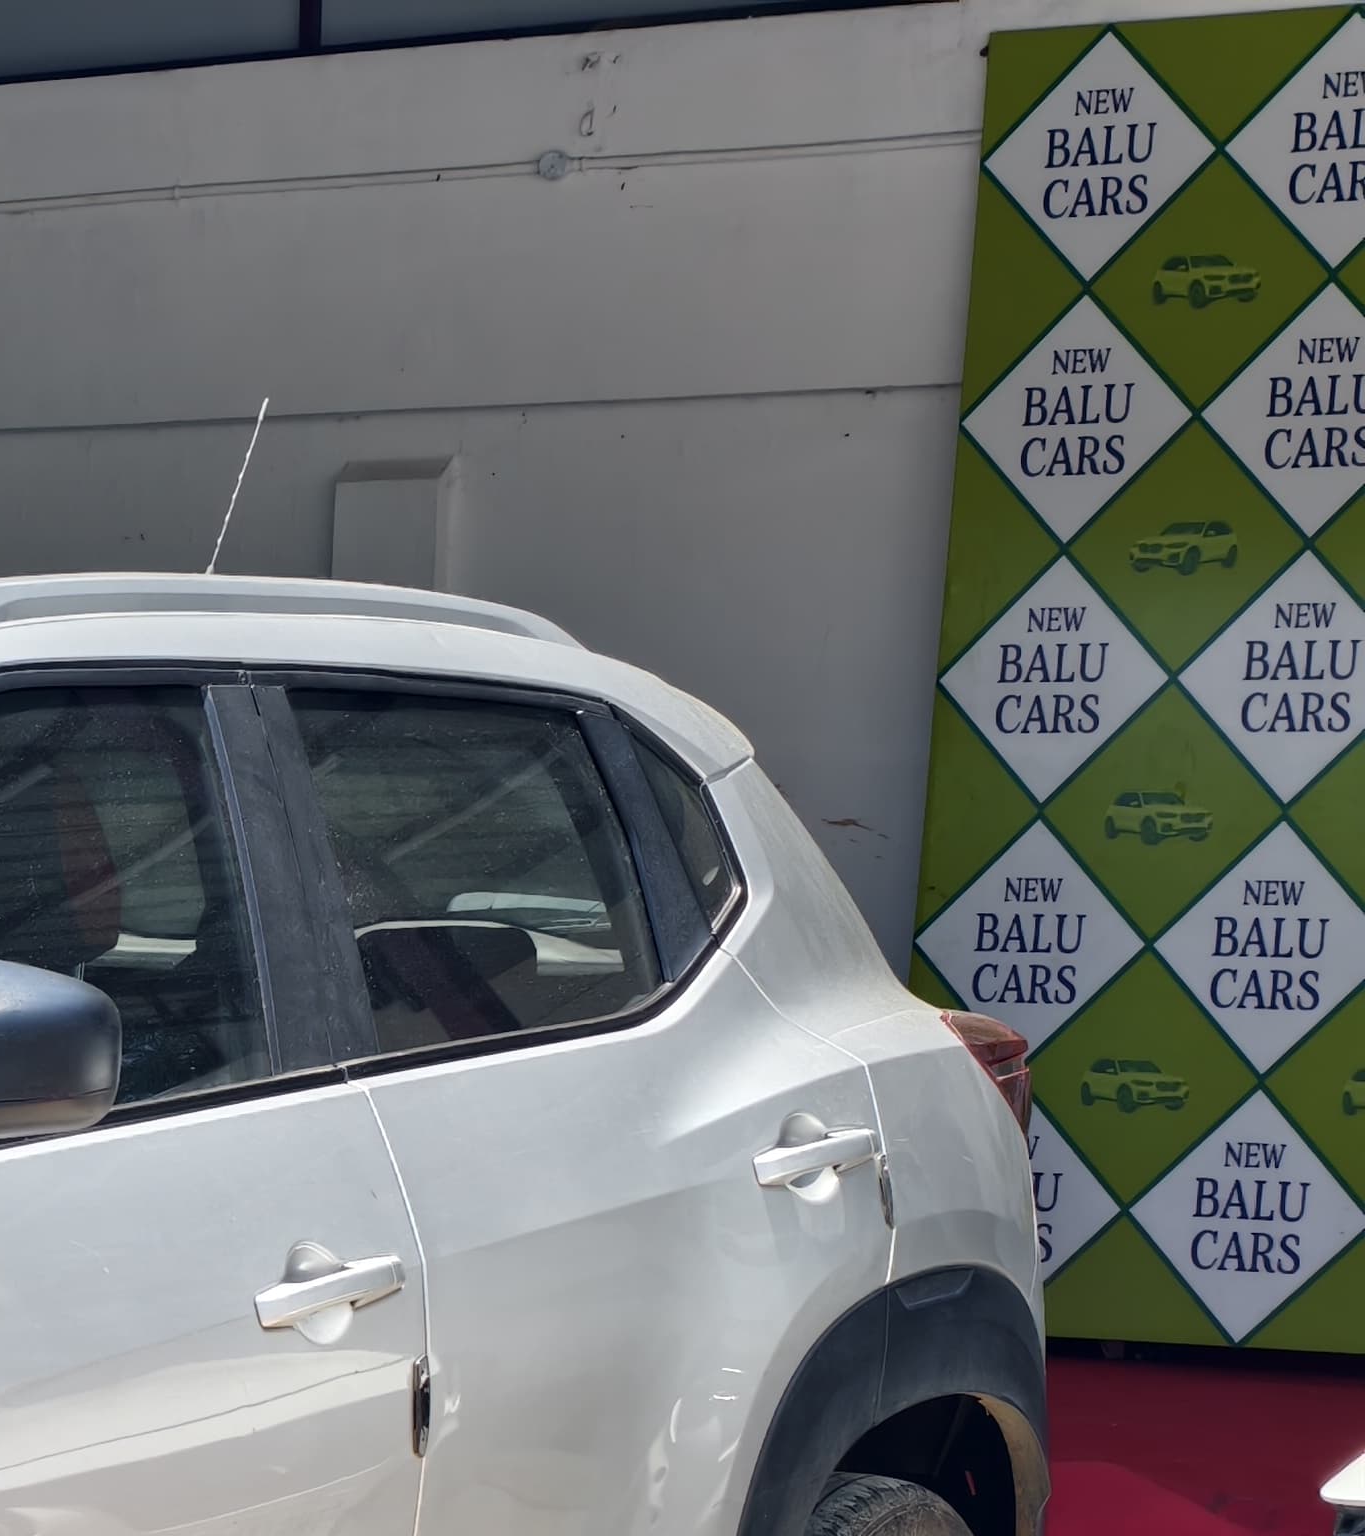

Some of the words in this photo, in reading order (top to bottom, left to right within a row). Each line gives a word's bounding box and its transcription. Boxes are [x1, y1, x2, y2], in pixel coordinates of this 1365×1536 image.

[1075, 87, 1134, 116] NEW
[1323, 71, 1365, 99] NE
[1045, 123, 1157, 168] BALU
[1043, 174, 1149, 219] CARS
[1052, 348, 1111, 375] NEW
[1298, 337, 1360, 364] NEW
[1022, 383, 1135, 426] BALU
[1021, 435, 1124, 477] CARS
[1027, 607, 1086, 632] NEW
[1275, 602, 1336, 628] NEW
[997, 643, 1109, 683] BALU
[1243, 640, 1362, 680] BALU
[996, 694, 1099, 733] CARS
[1241, 692, 1350, 732] CARS
[1004, 877, 1063, 902] NEW
[1243, 880, 1305, 906] NEW
[974, 913, 1086, 953] BALU
[1212, 917, 1329, 959] BALU
[972, 963, 1076, 1004] CARS
[1210, 968, 1320, 1012] CARS
[1224, 1142, 1287, 1169] NEW
[1193, 1178, 1310, 1222] BALU
[1191, 1230, 1300, 1274] CARS
